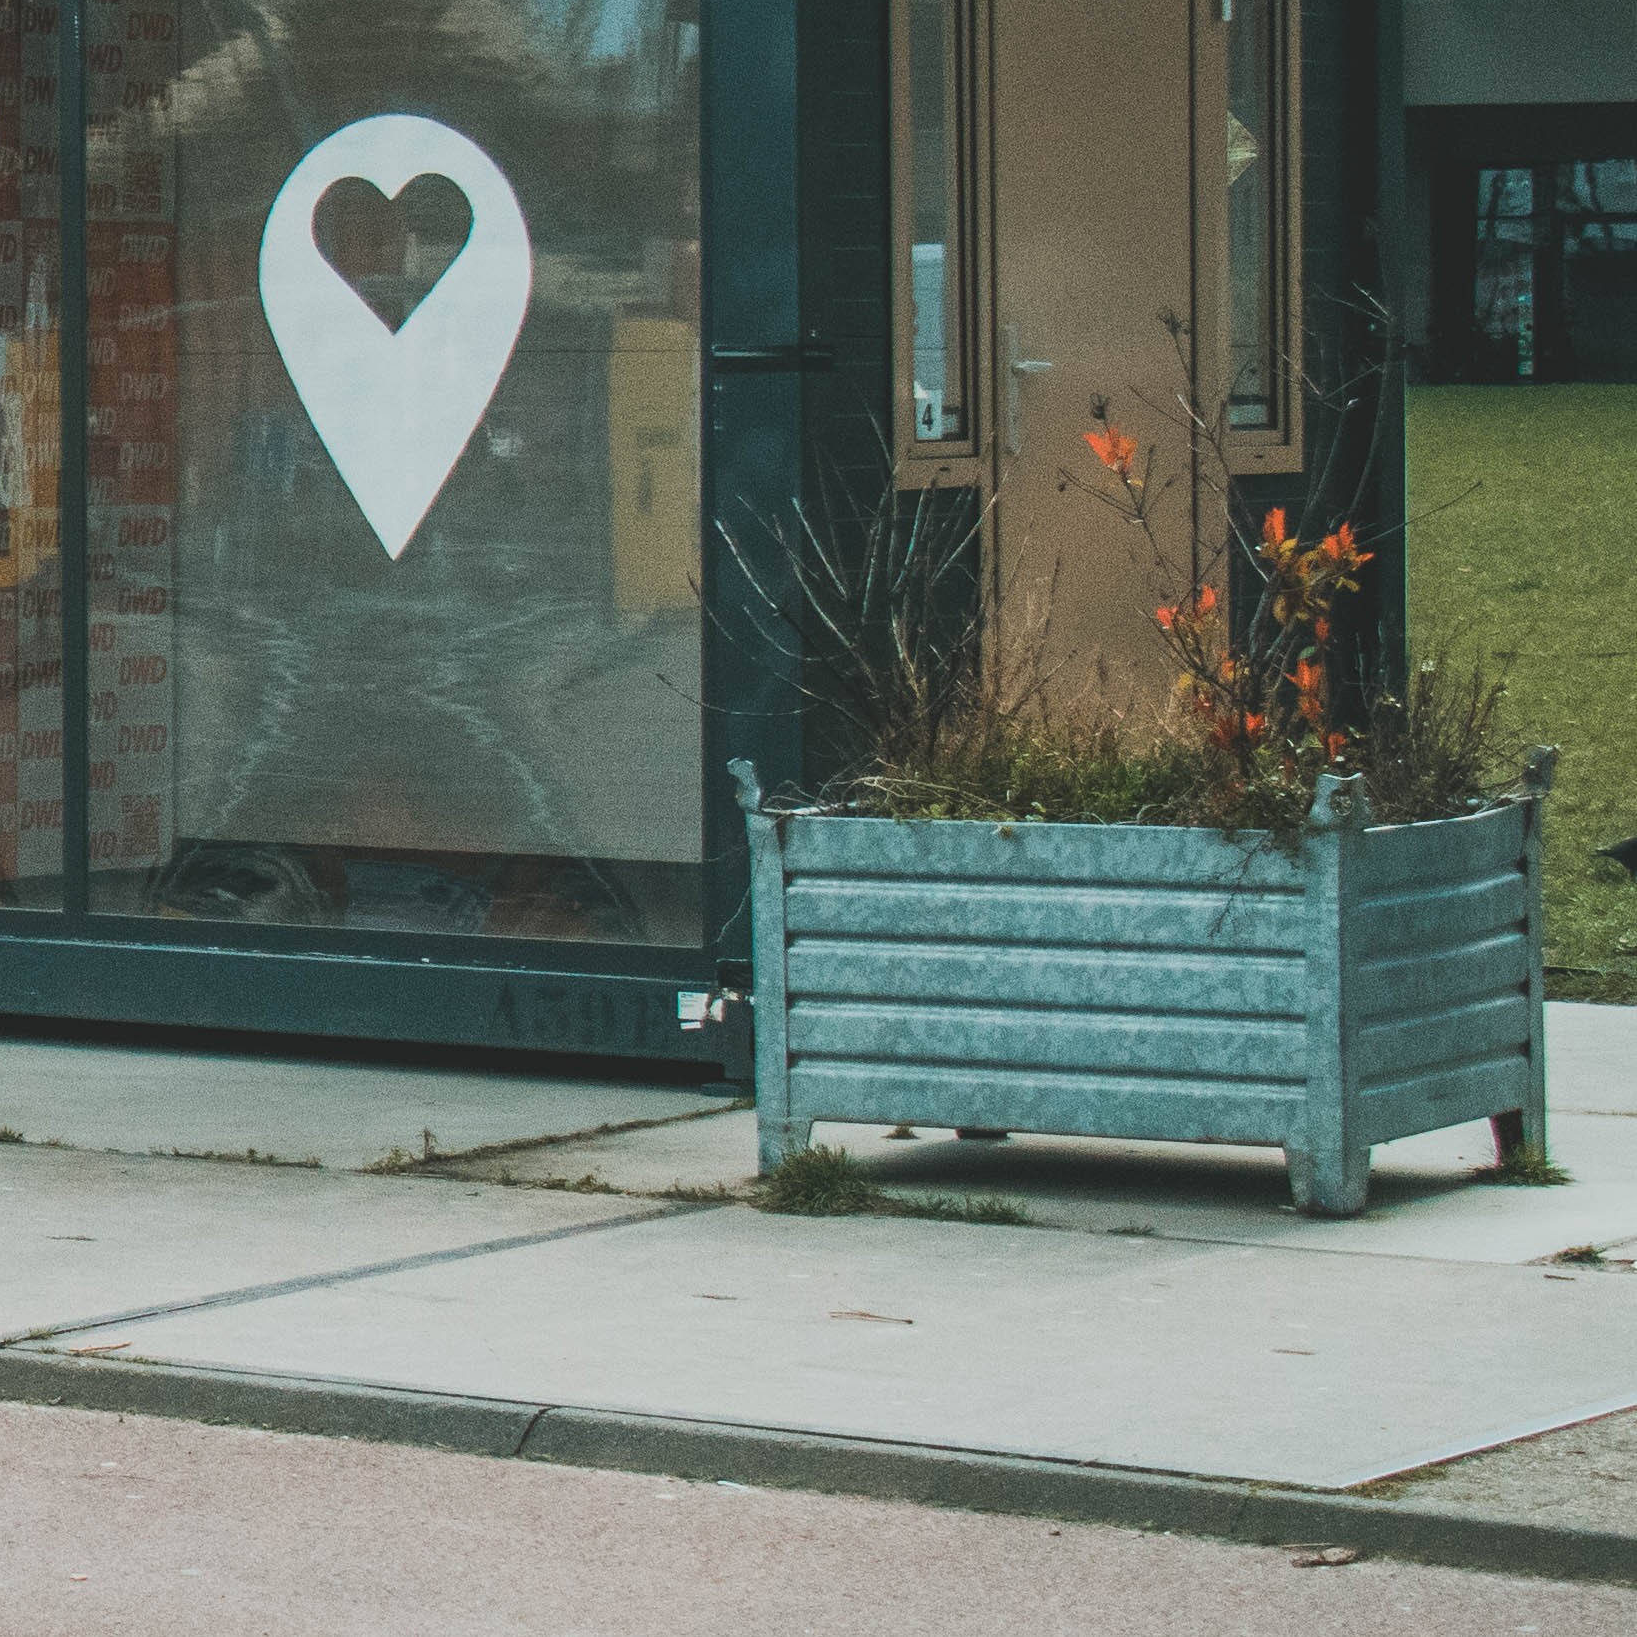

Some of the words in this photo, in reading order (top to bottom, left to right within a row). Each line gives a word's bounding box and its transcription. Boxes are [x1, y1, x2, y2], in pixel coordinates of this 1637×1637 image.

[26, 6, 58, 35] DW
[126, 13, 175, 43] DWD
[86, 43, 124, 74] WD
[25, 75, 58, 106] DW
[119, 233, 169, 263] DWD
[120, 371, 169, 400] DWD
[921, 403, 934, 432] 4
[118, 440, 169, 471] DWD
[117, 517, 168, 548] DWD
[117, 586, 168, 615] DWD
[118, 654, 168, 686] DWD
[118, 724, 168, 755] DWD
